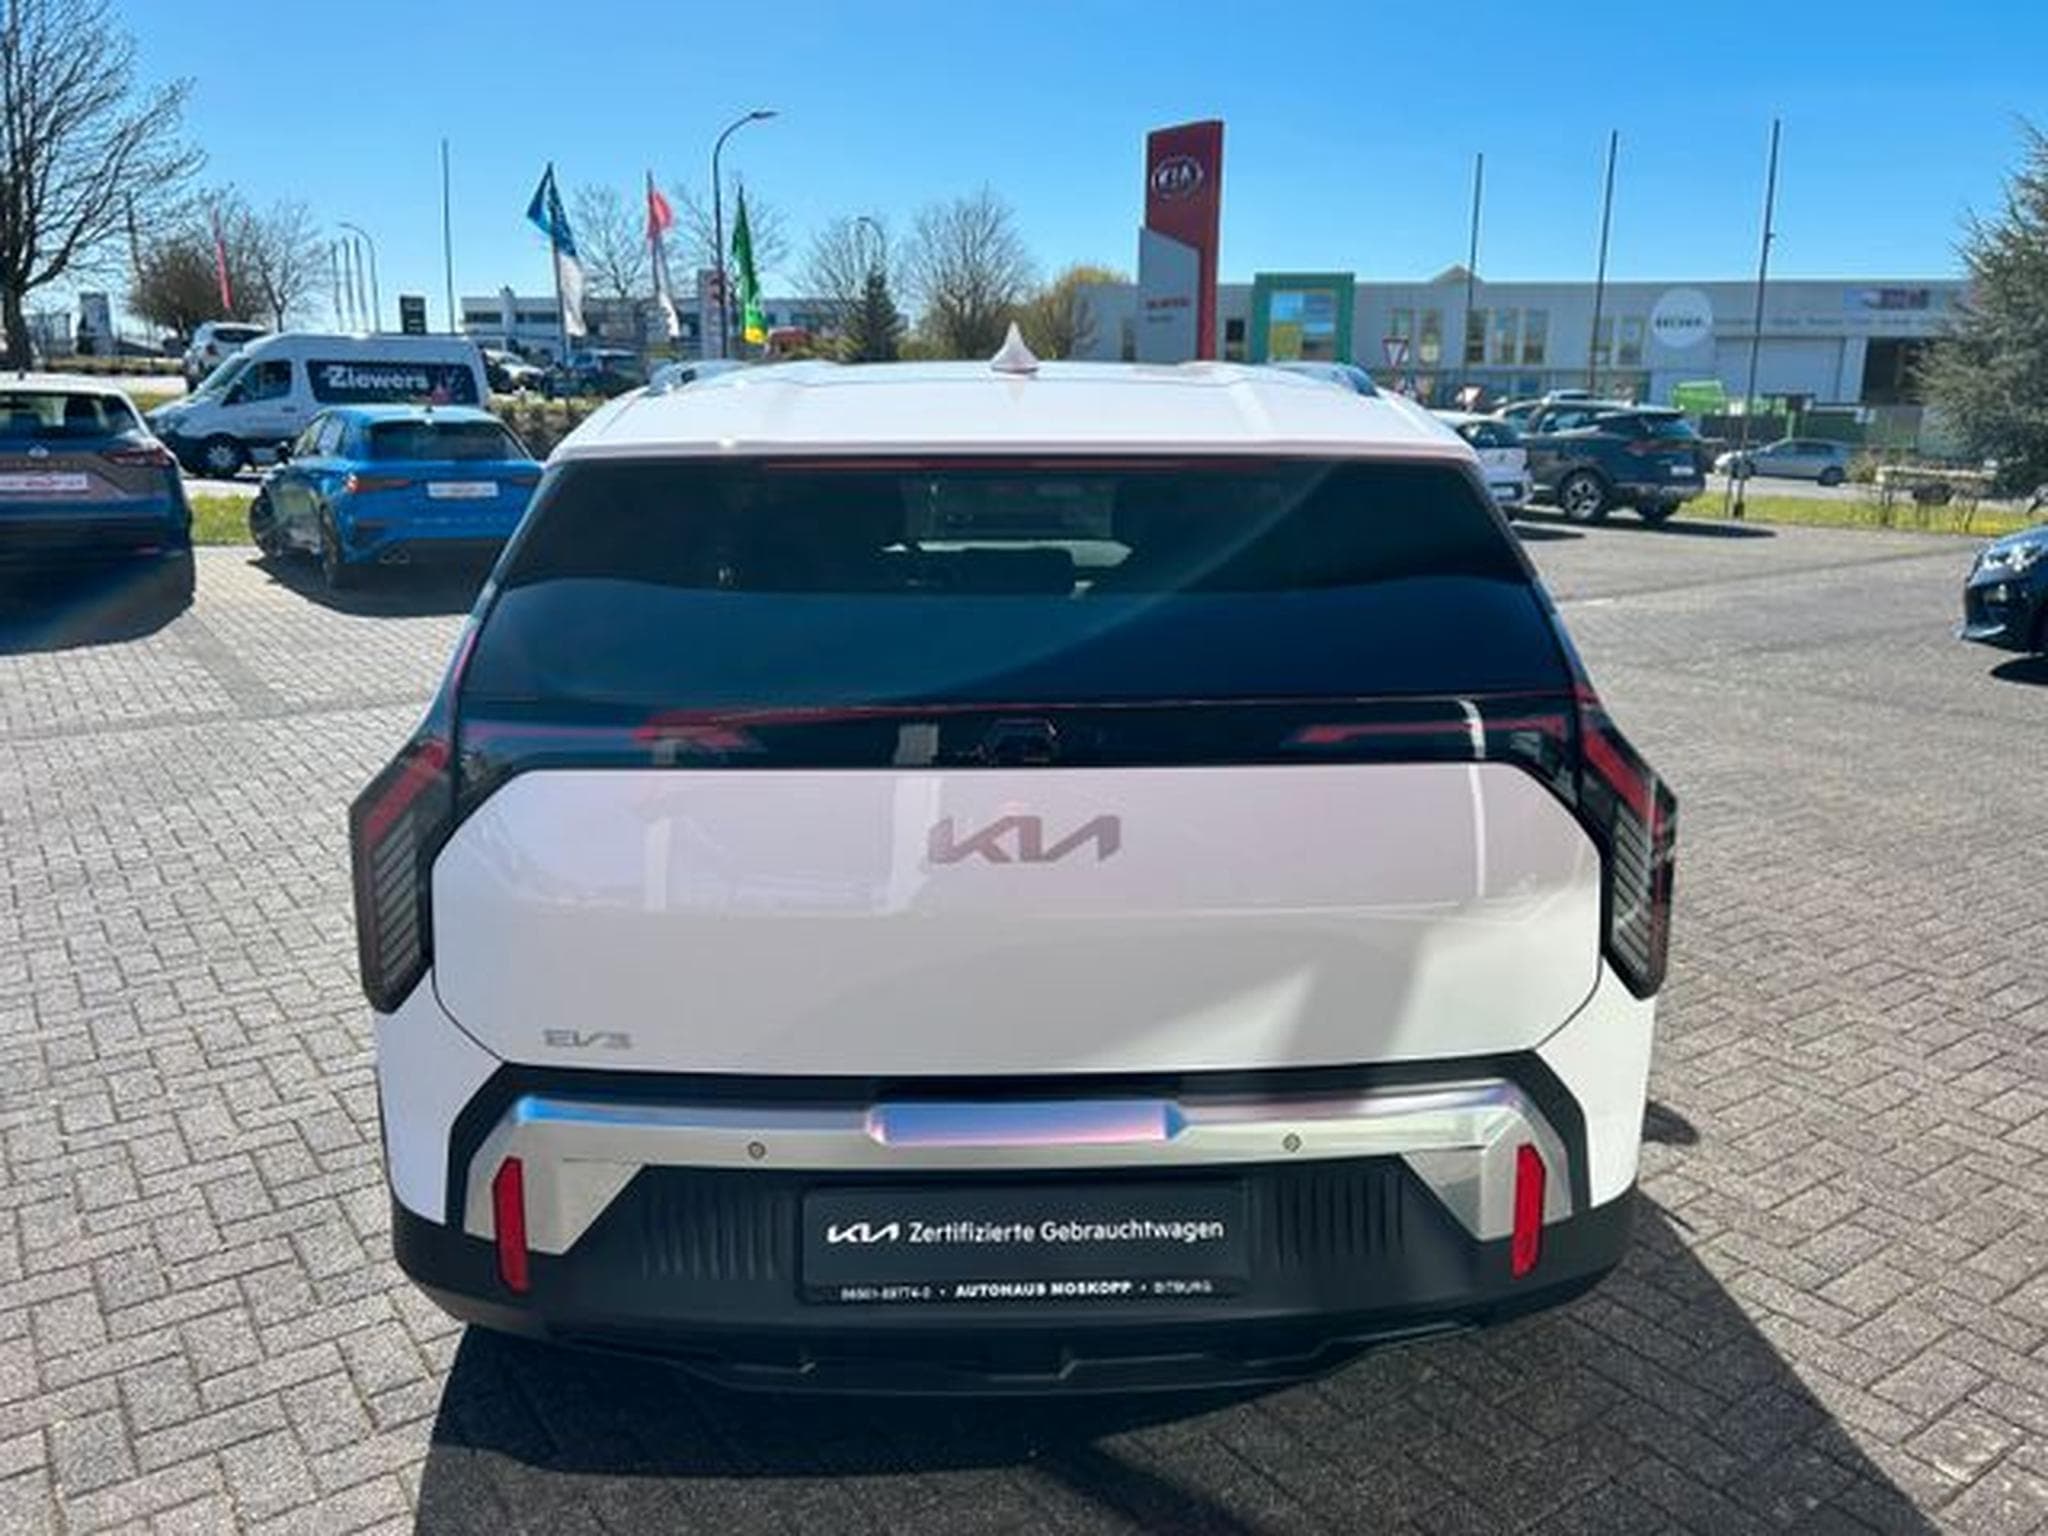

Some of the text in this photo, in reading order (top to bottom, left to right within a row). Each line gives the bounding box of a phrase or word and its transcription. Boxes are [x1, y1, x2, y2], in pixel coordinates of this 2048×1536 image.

[928, 815, 1120, 863] KIA
[543, 1030, 631, 1050] EV3
[826, 1219, 1224, 1243] KIA Zertifizierte Gebrauchtwagen
[955, 1283, 1046, 1298] AUTOHAUS
[1050, 1281, 1132, 1295] MOSKOPP
